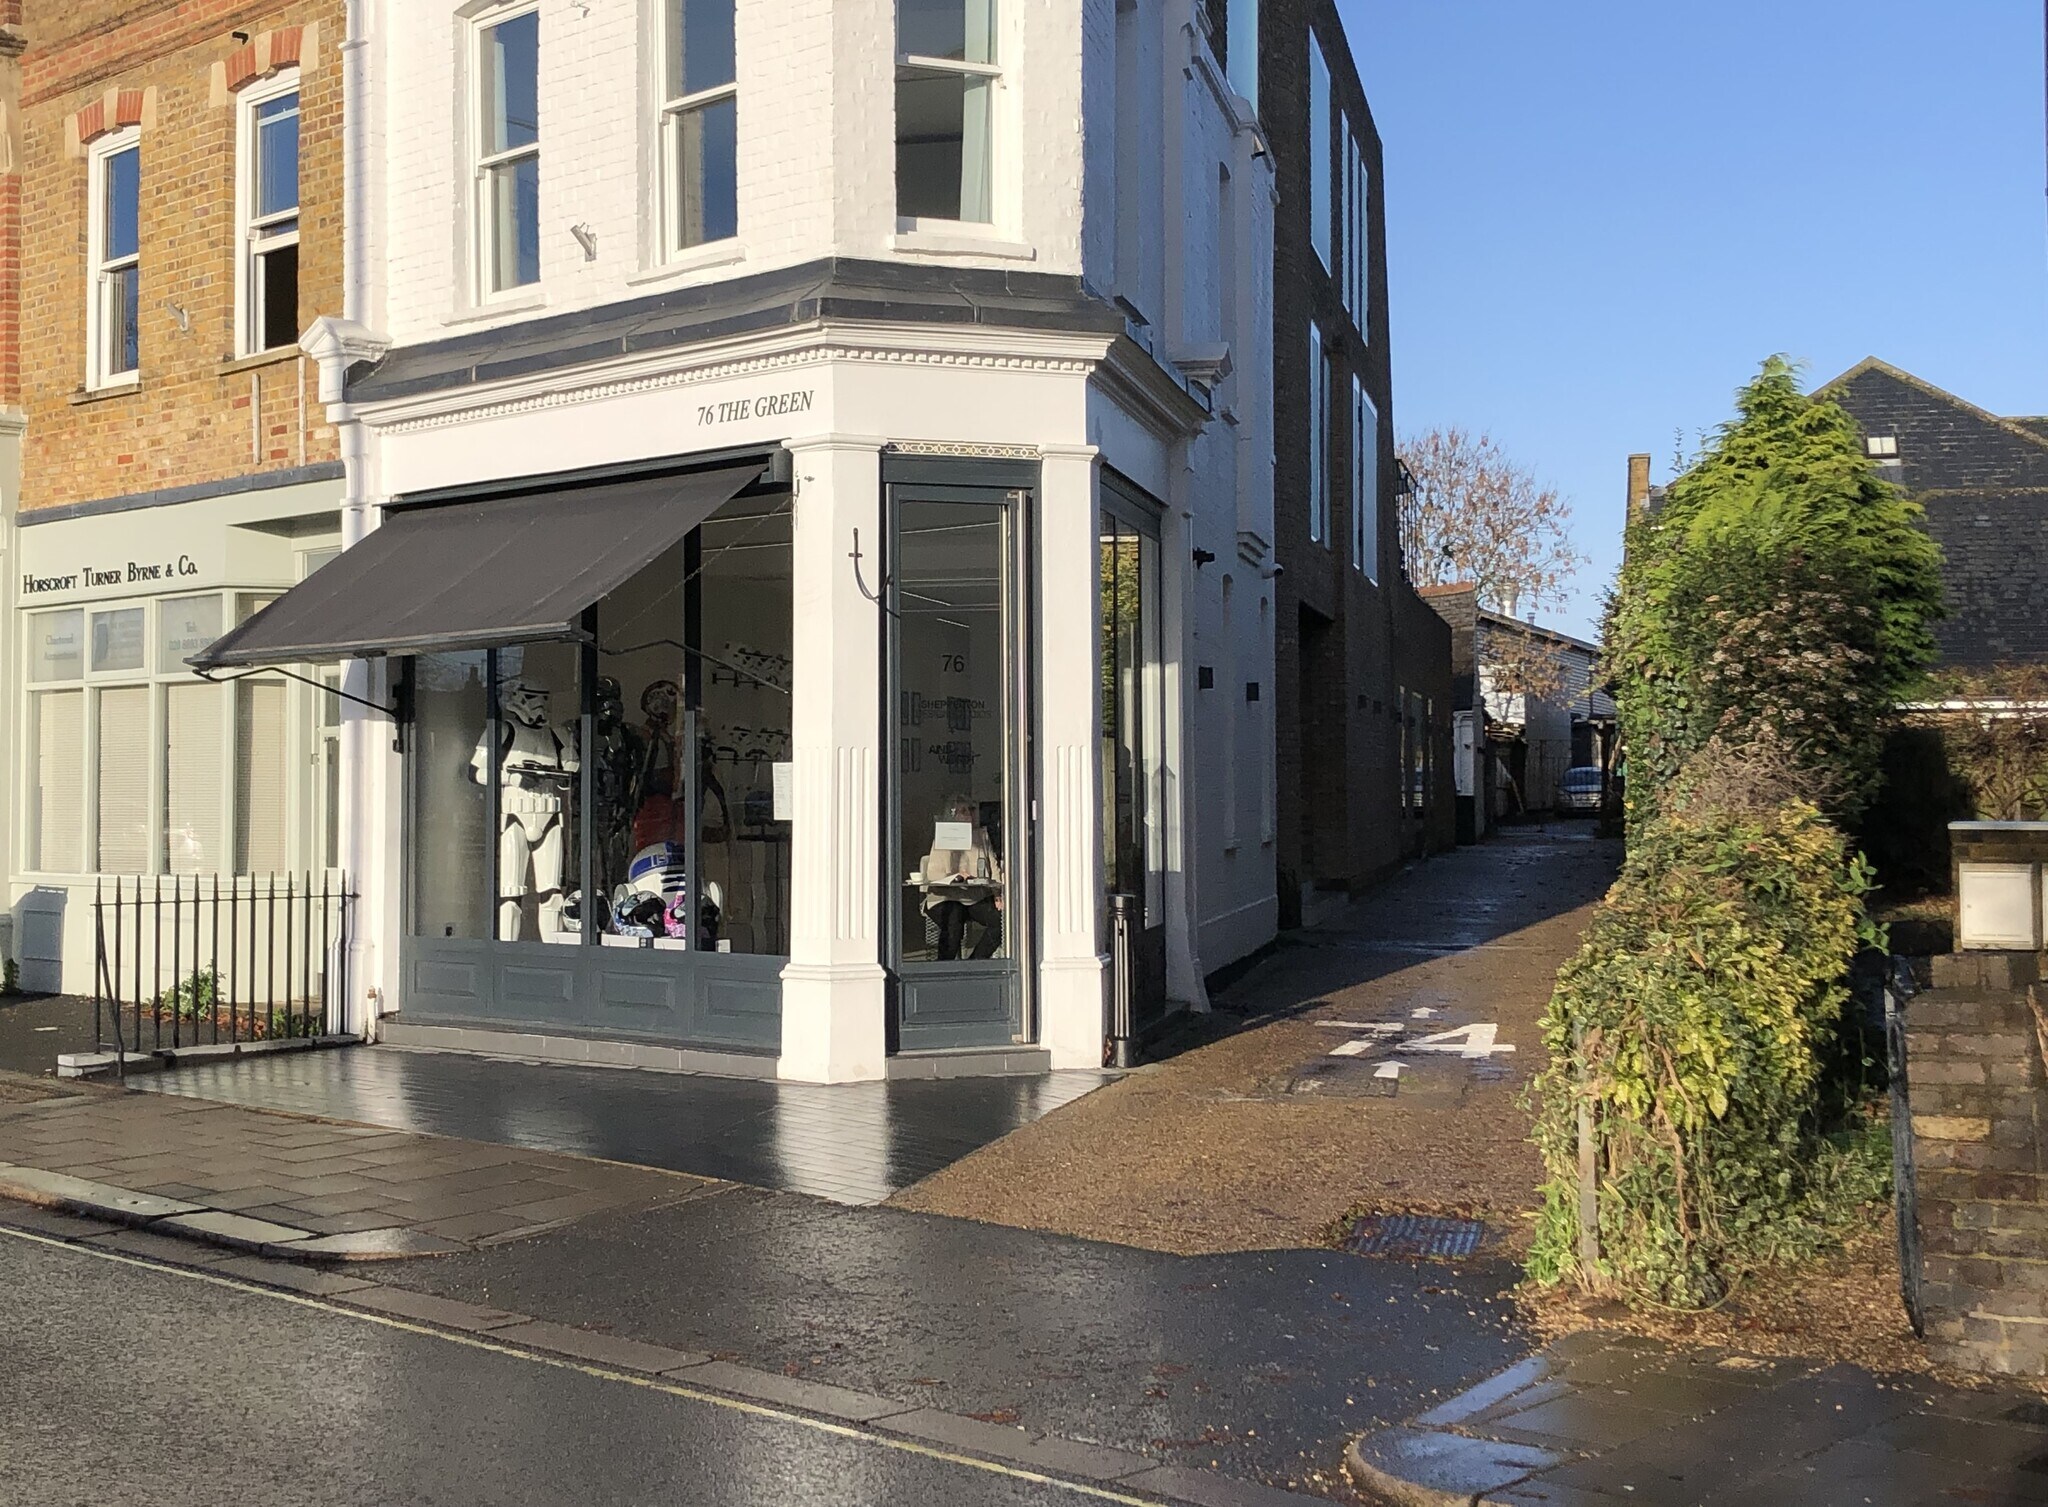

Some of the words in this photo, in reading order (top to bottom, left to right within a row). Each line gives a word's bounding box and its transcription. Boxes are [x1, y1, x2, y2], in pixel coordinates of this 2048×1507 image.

[697, 404, 715, 426] 76
[718, 399, 751, 423] THE
[754, 390, 815, 418] GREEN
[165, 563, 174, 578] &
[941, 654, 965, 673] 76
